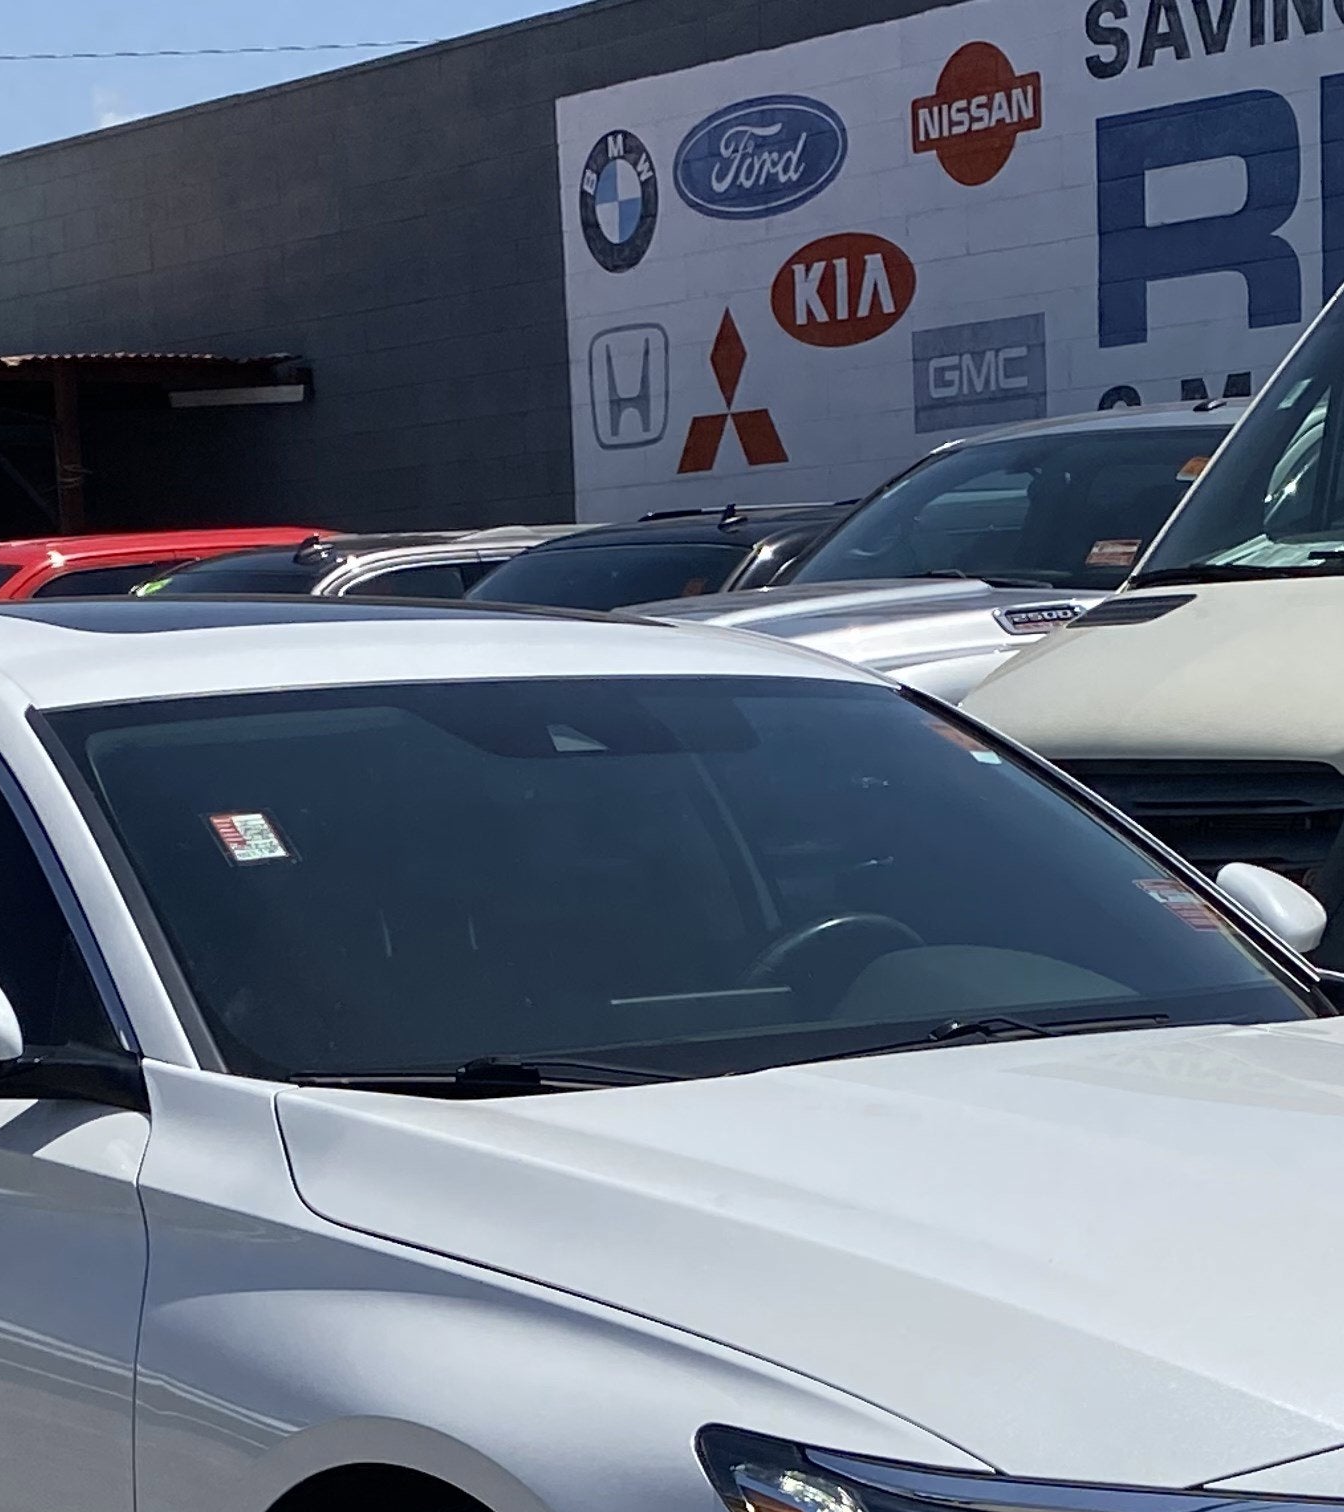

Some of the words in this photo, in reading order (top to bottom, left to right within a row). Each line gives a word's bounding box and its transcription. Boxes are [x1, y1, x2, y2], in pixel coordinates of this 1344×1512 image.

[918, 85, 1034, 141] NISSAN
[583, 133, 654, 196] BMW
[711, 122, 807, 193] Ford
[791, 253, 896, 325] KIA
[928, 346, 1028, 399] GMC
